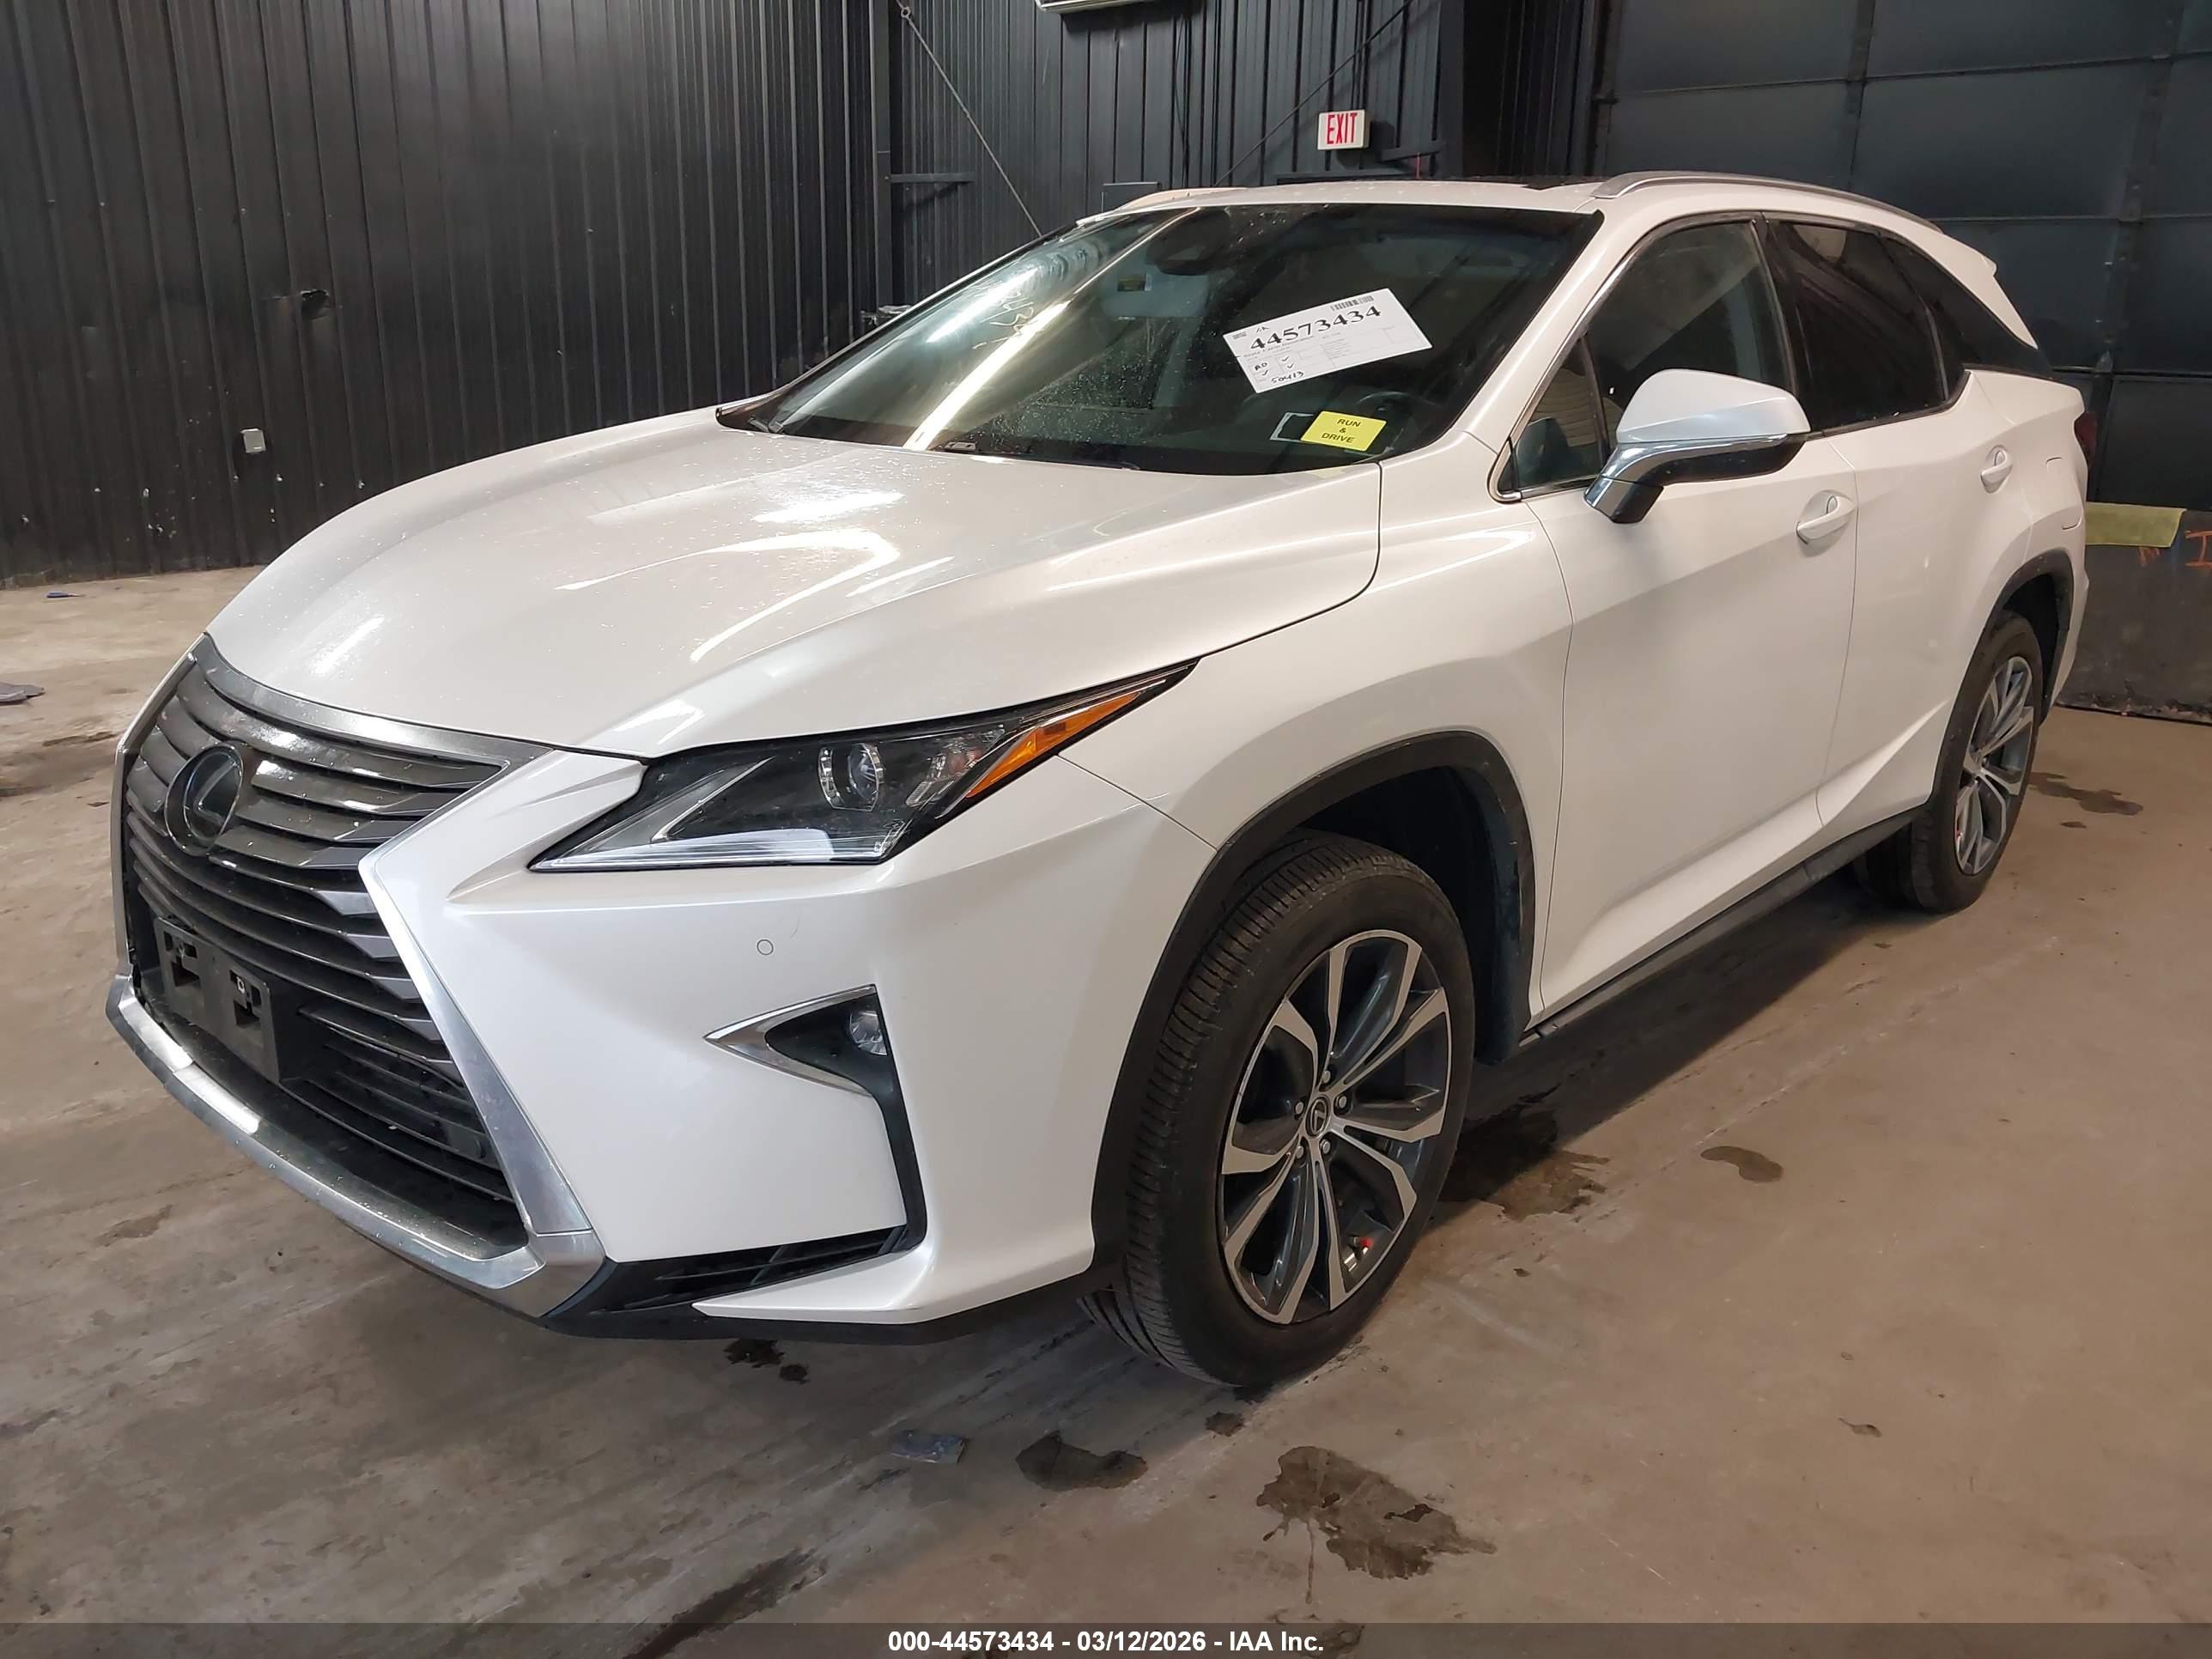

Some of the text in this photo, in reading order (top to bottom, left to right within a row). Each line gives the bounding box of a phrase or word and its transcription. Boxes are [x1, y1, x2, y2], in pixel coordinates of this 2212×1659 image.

[1327, 112, 1358, 144] EXIT
[1250, 306, 1382, 349] 44573434
[1337, 418, 1361, 427] RUN
[1322, 433, 1356, 443] DRIVE
